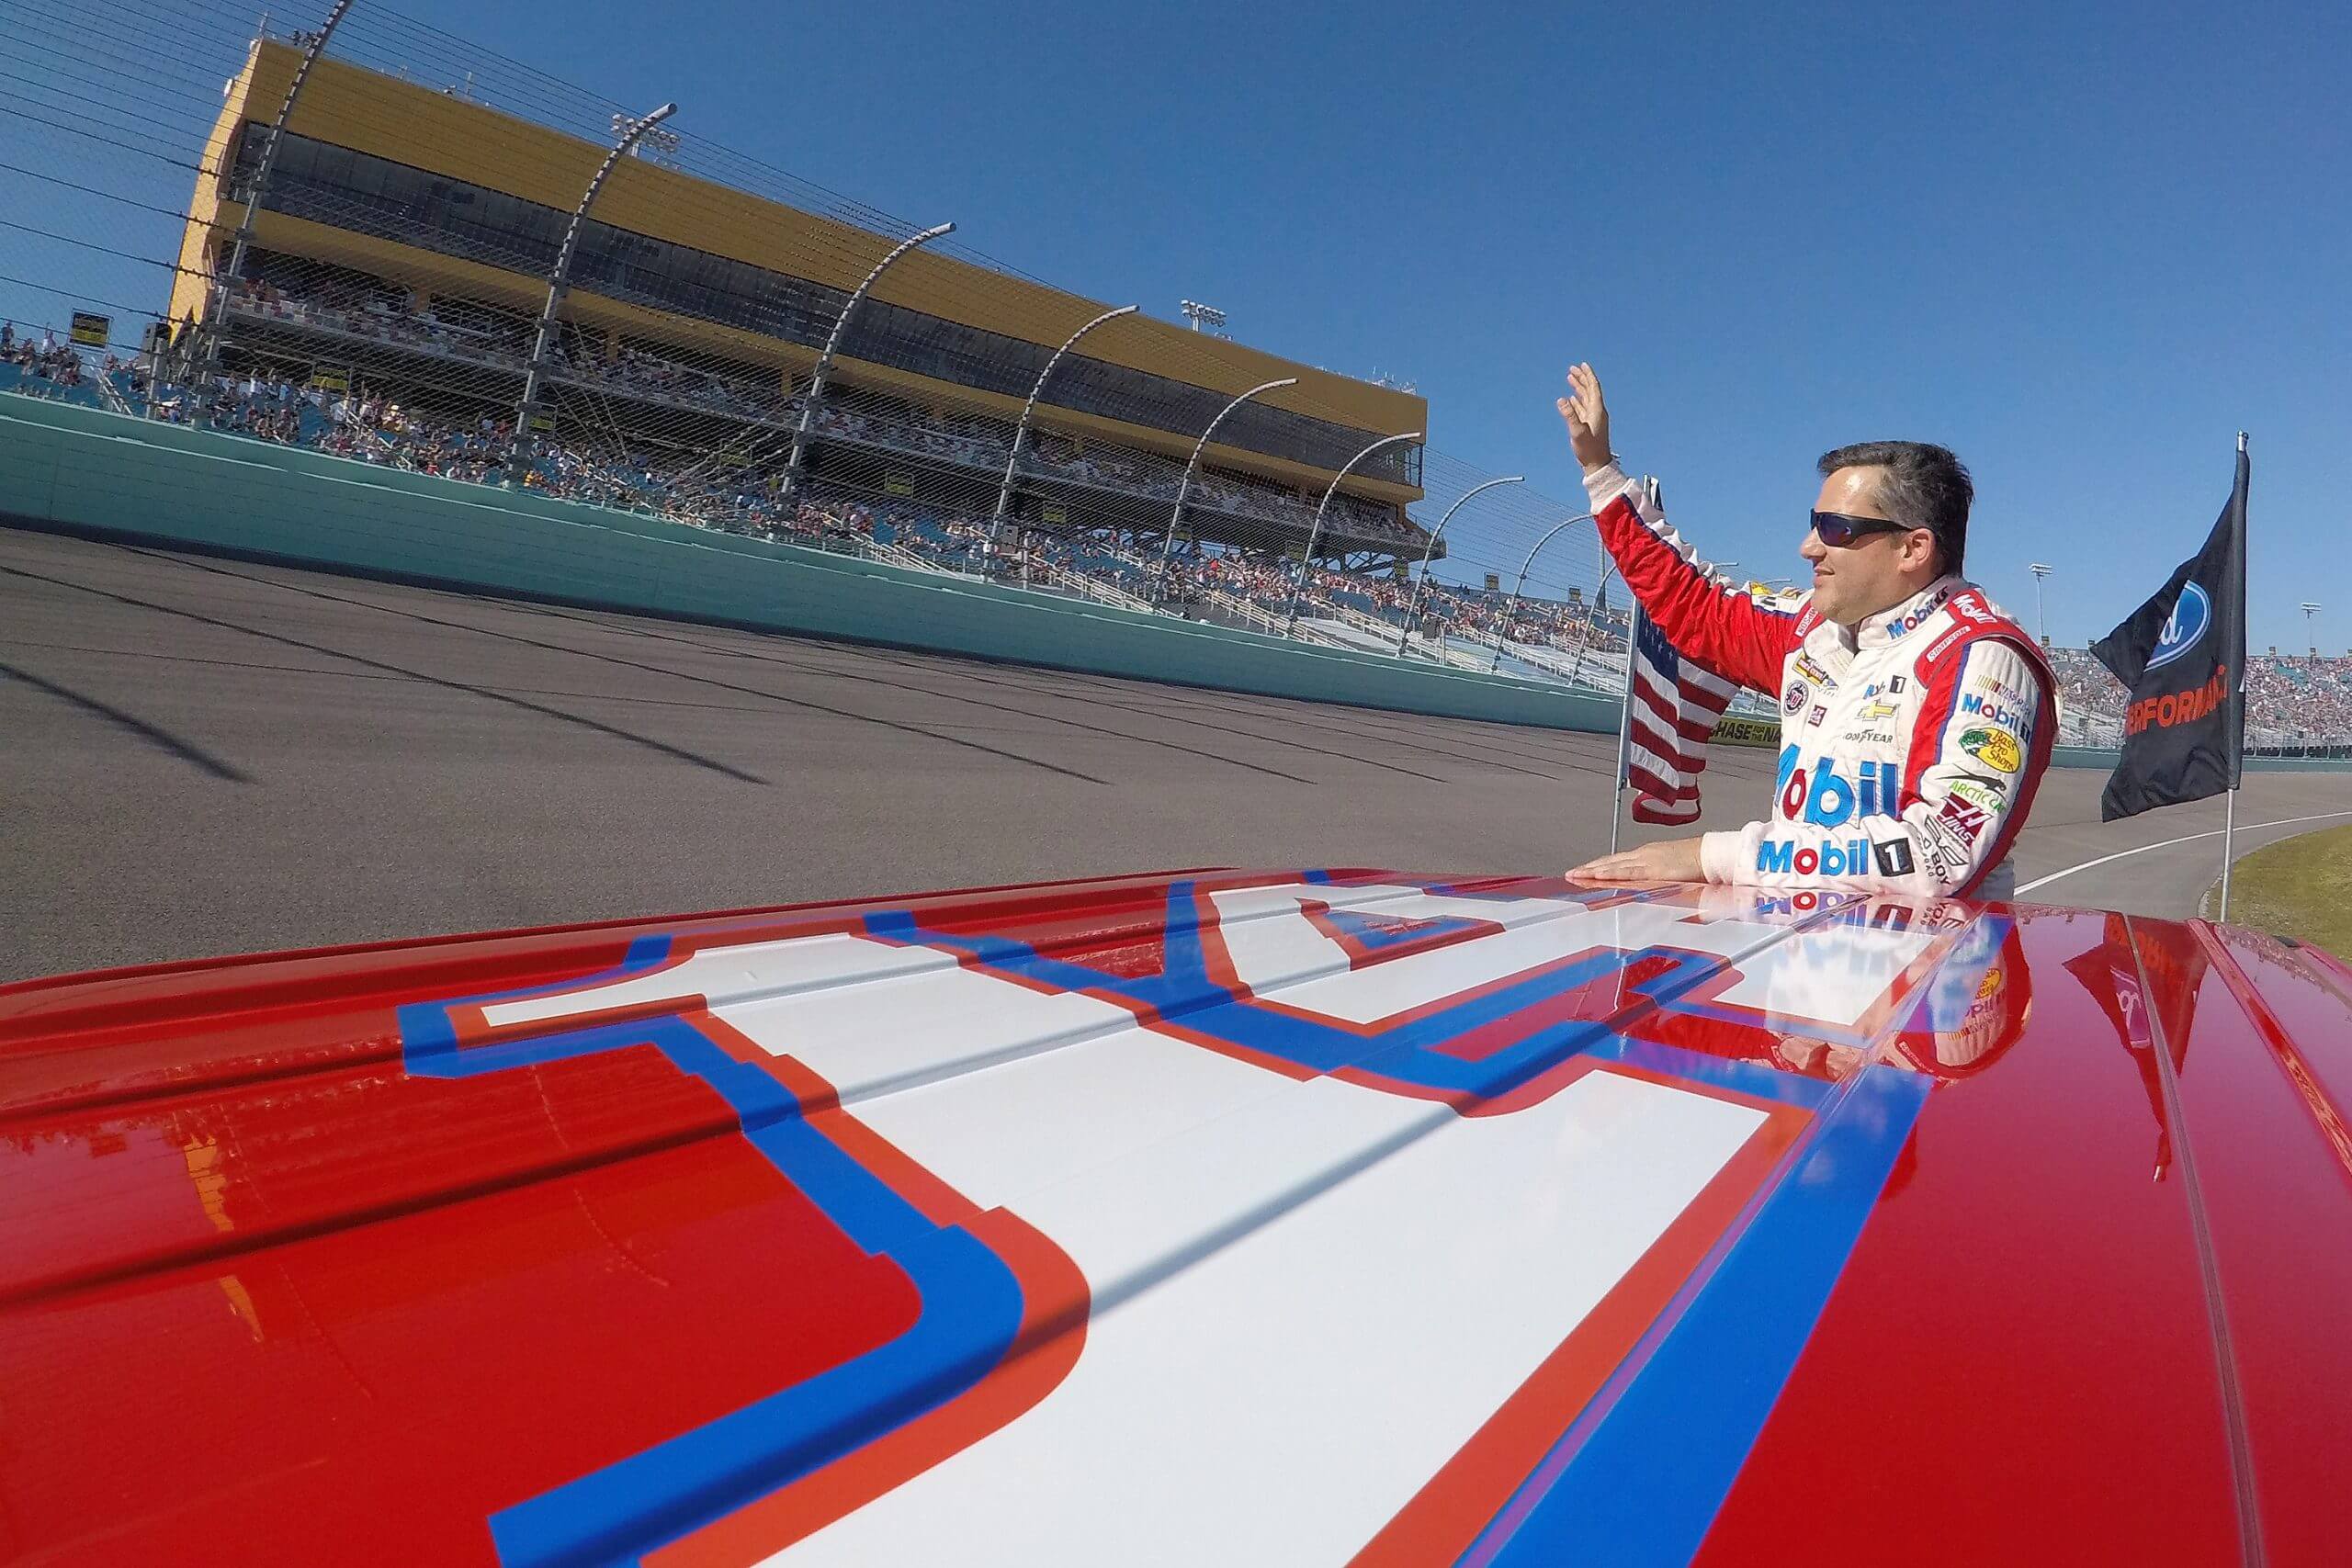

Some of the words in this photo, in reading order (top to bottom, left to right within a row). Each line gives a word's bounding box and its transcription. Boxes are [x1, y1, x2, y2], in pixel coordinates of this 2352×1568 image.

[1798, 607, 1818, 634] MPSON
[1885, 599, 1937, 640] Mobil
[1928, 626, 1968, 659] SIMPSON
[1962, 693, 2020, 732] Mobil
[1991, 741, 2008, 756] Pro
[1994, 730, 2016, 751] Bass
[1986, 750, 2014, 770] Shops
[1949, 779, 1987, 805] ARCTIC
[1756, 839, 1869, 875] Mobil
[1930, 852, 1951, 885] BOY
